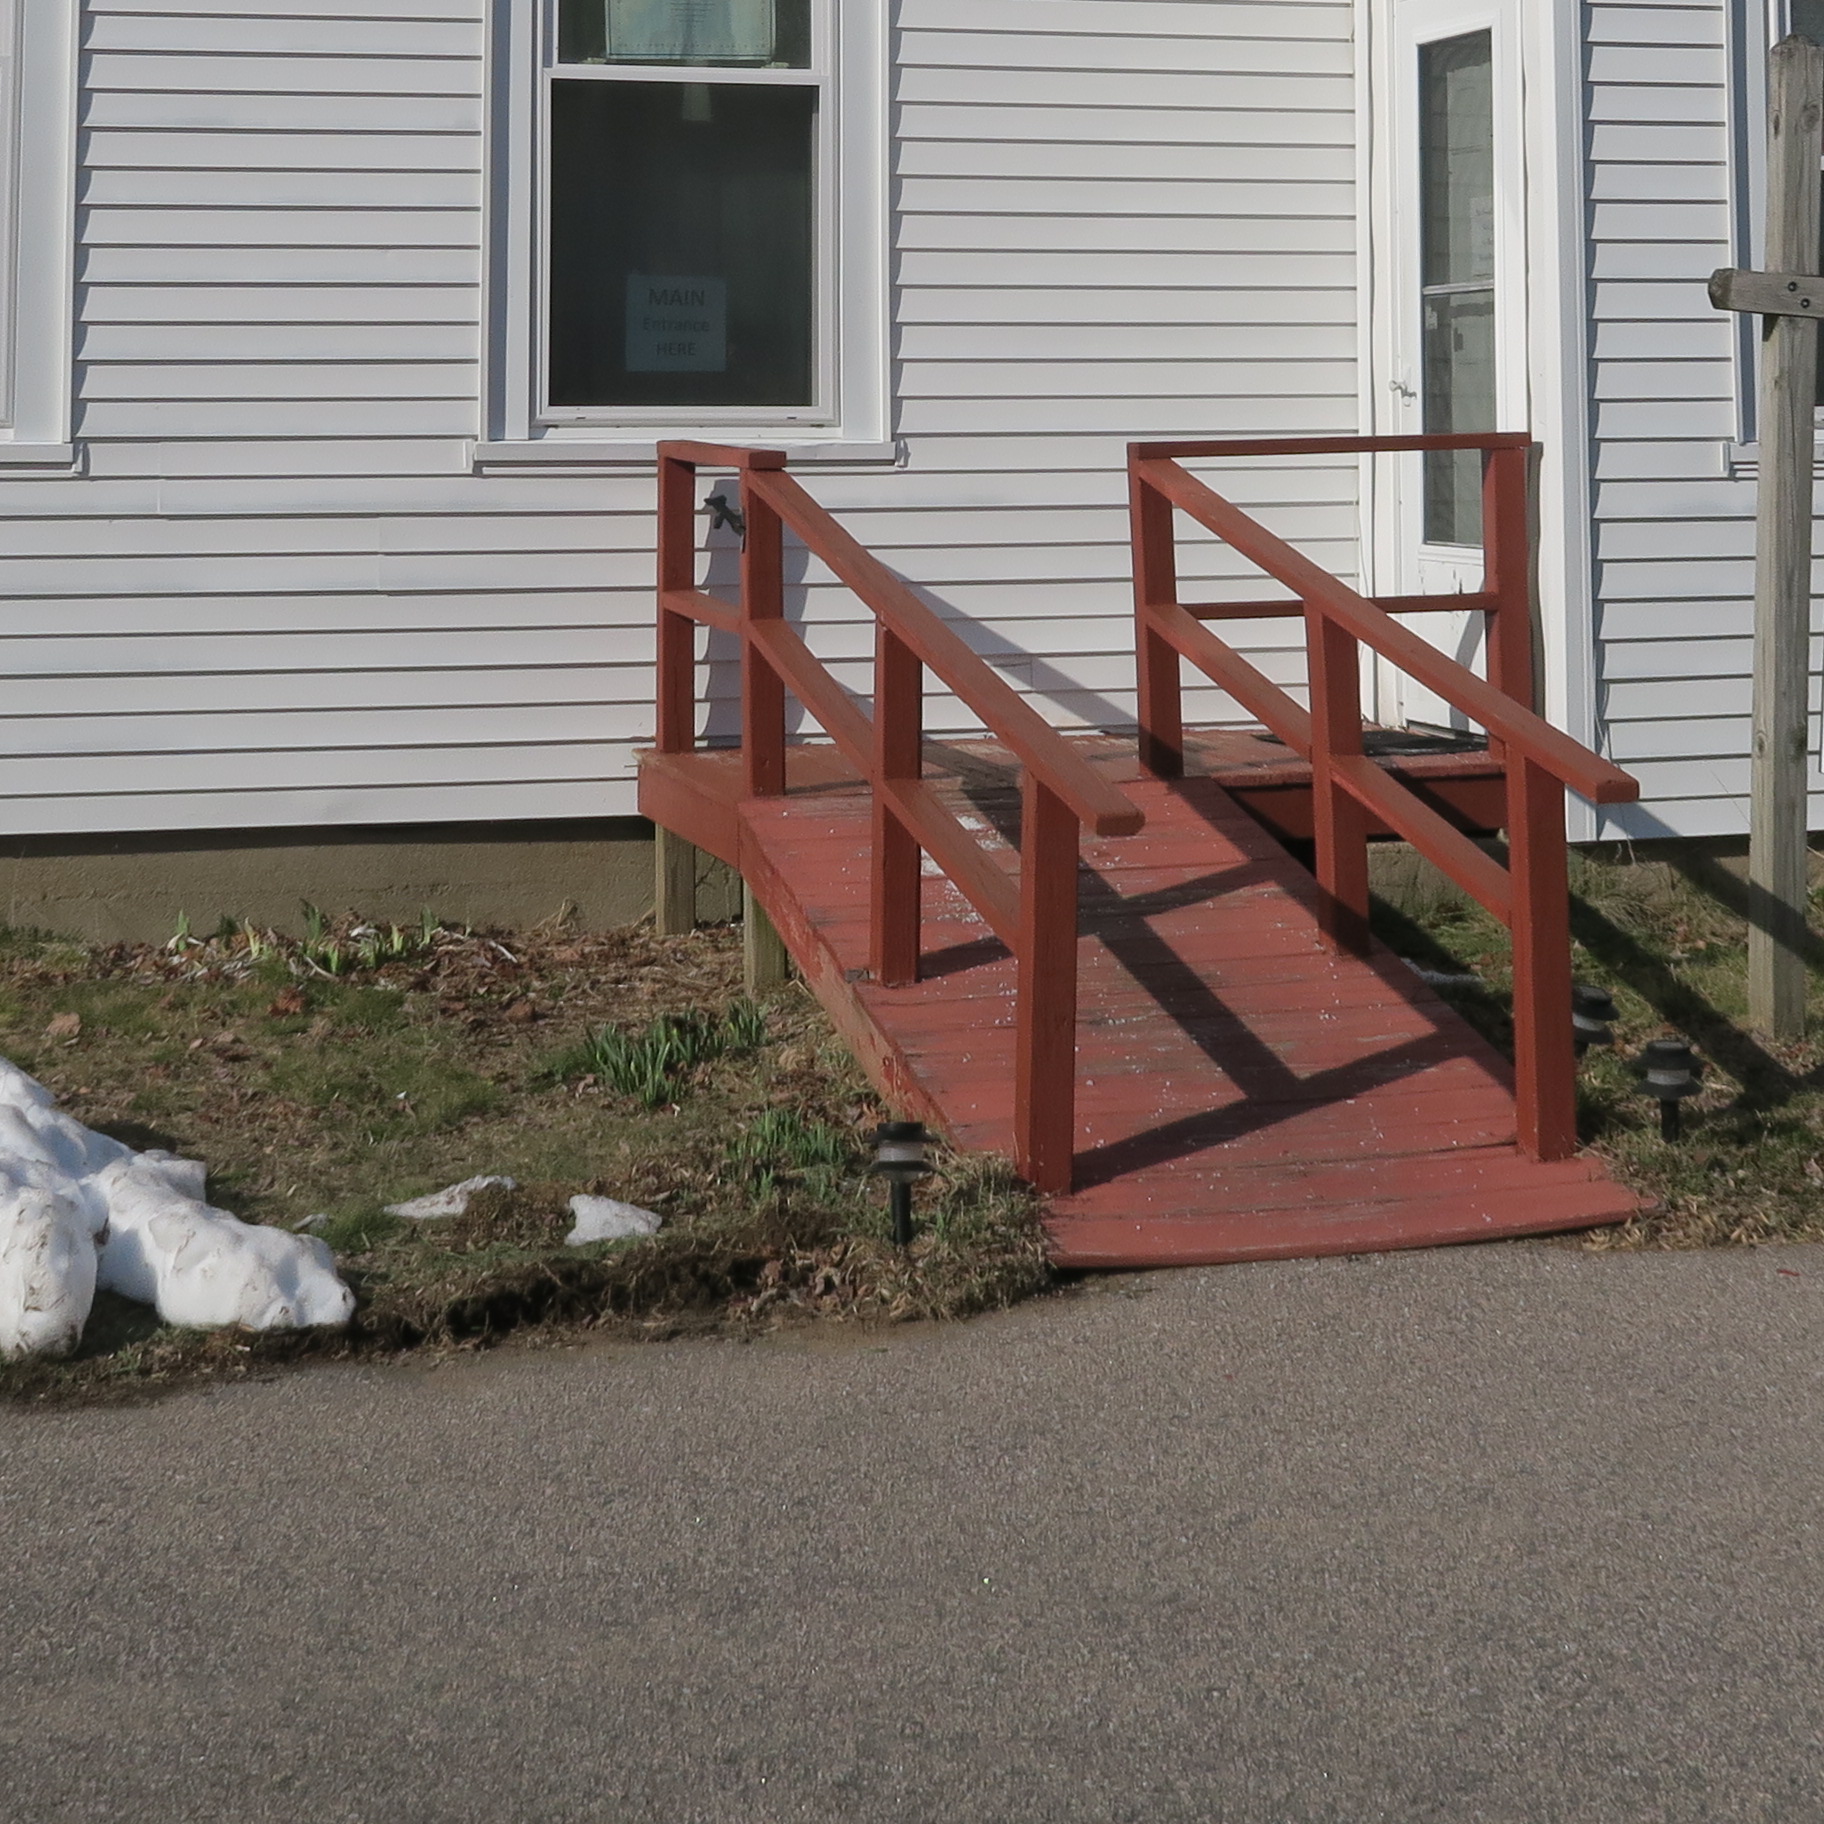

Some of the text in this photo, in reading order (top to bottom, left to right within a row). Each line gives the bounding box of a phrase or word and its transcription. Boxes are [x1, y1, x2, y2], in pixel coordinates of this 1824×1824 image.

[648, 288, 705, 306] MAIN
[642, 316, 711, 332] Entrance
[656, 342, 697, 356] HERE
